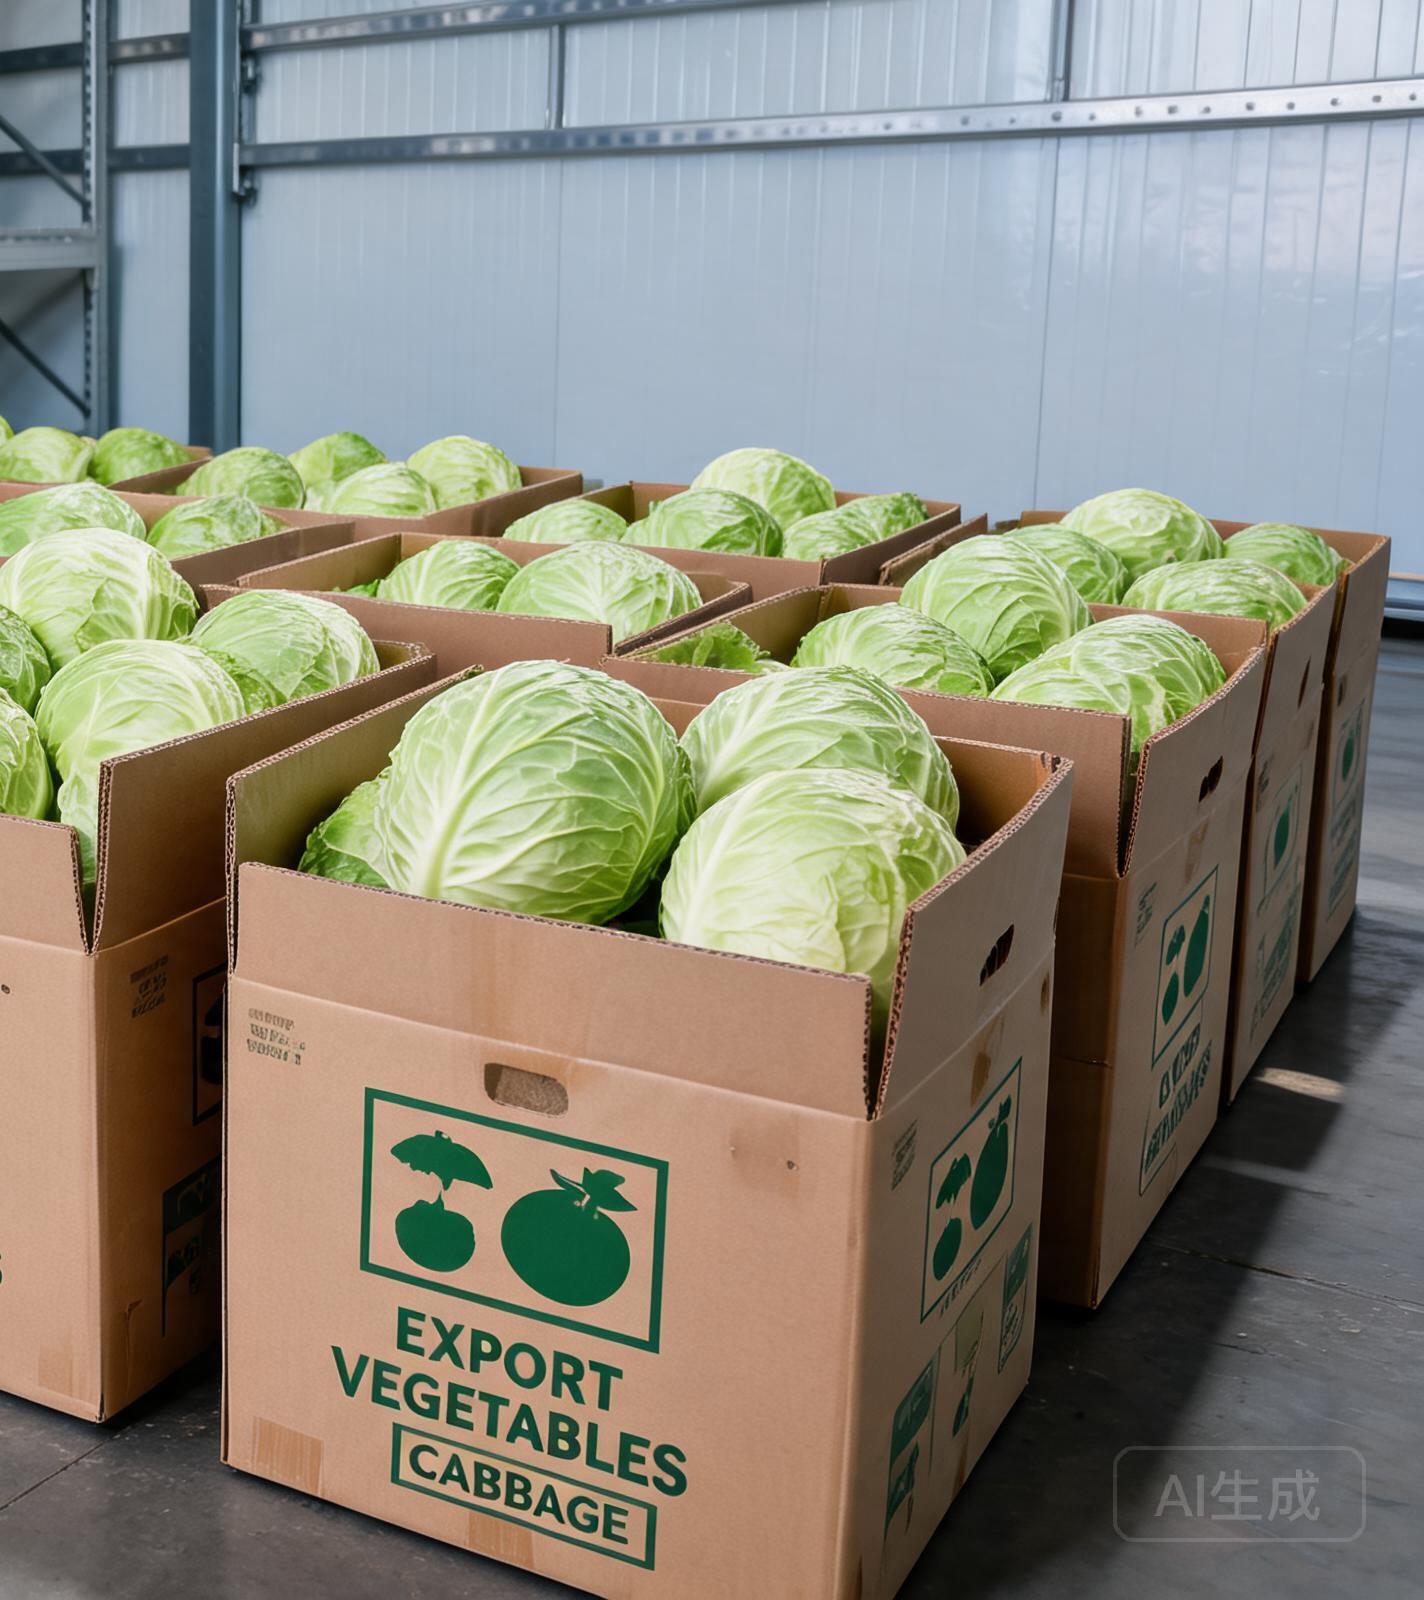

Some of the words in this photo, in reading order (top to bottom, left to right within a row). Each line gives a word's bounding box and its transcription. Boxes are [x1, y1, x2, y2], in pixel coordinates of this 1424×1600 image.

[396, 1305, 624, 1411] EXPORT
[330, 1344, 688, 1497] VEGETABLES
[408, 1443, 629, 1545] CABBAGE
